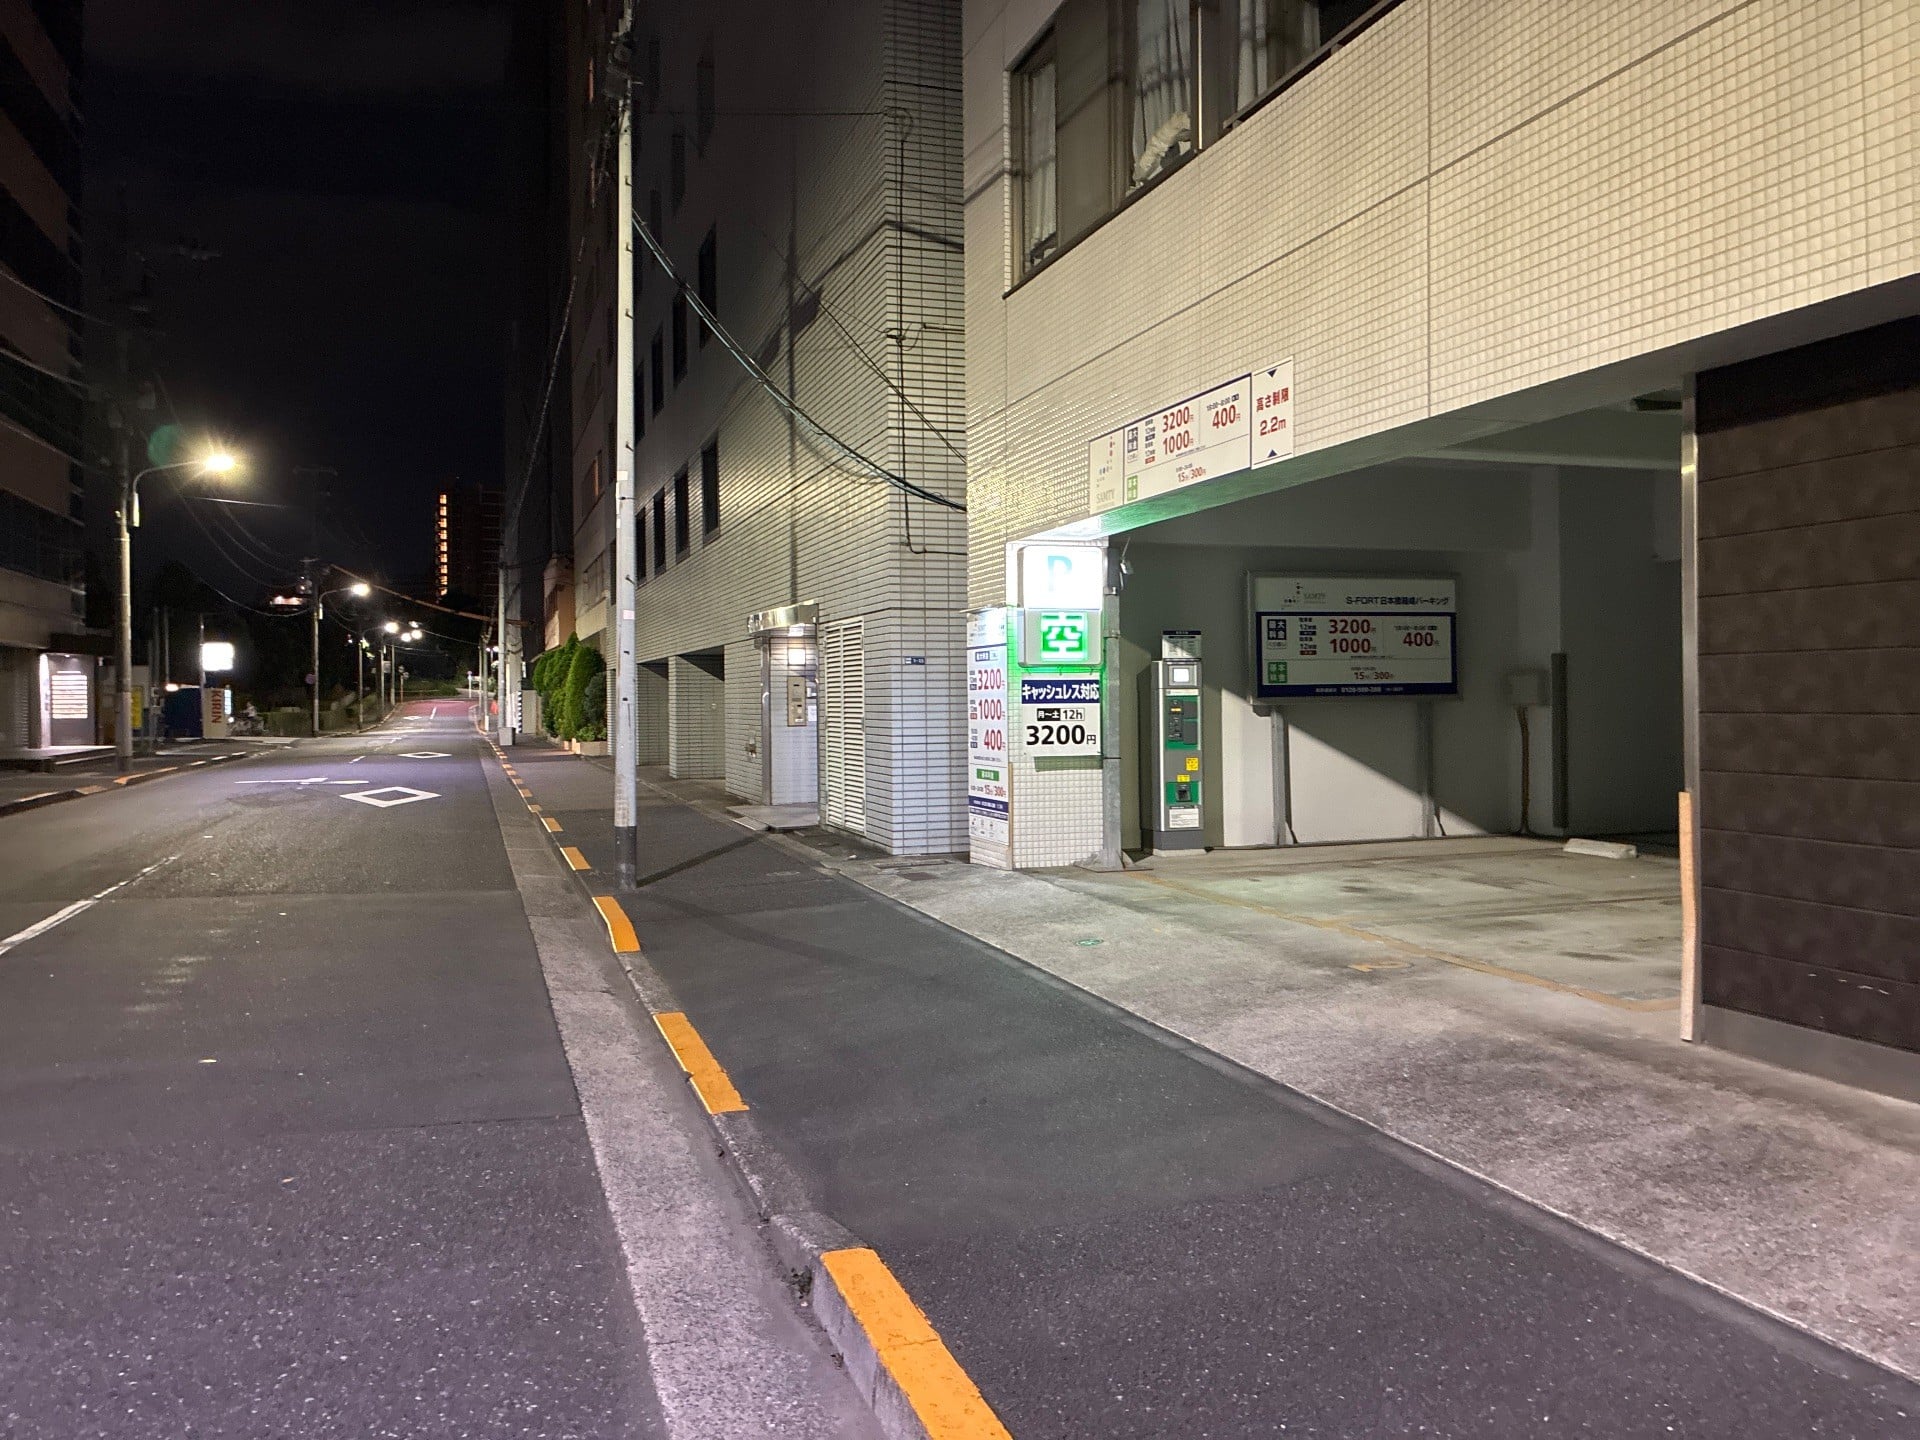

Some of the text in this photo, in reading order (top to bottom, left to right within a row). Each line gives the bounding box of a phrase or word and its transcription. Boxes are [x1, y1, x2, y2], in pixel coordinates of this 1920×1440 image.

[1260, 416, 1287, 436] 2.2m
[1047, 555, 1073, 592] P
[1041, 613, 1084, 659] 空
[1022, 683, 1100, 700] キャッシュレス対応
[211, 690, 222, 723] KIRIN
[1063, 709, 1083, 720] 12h
[1026, 725, 1097, 745] 3200円
